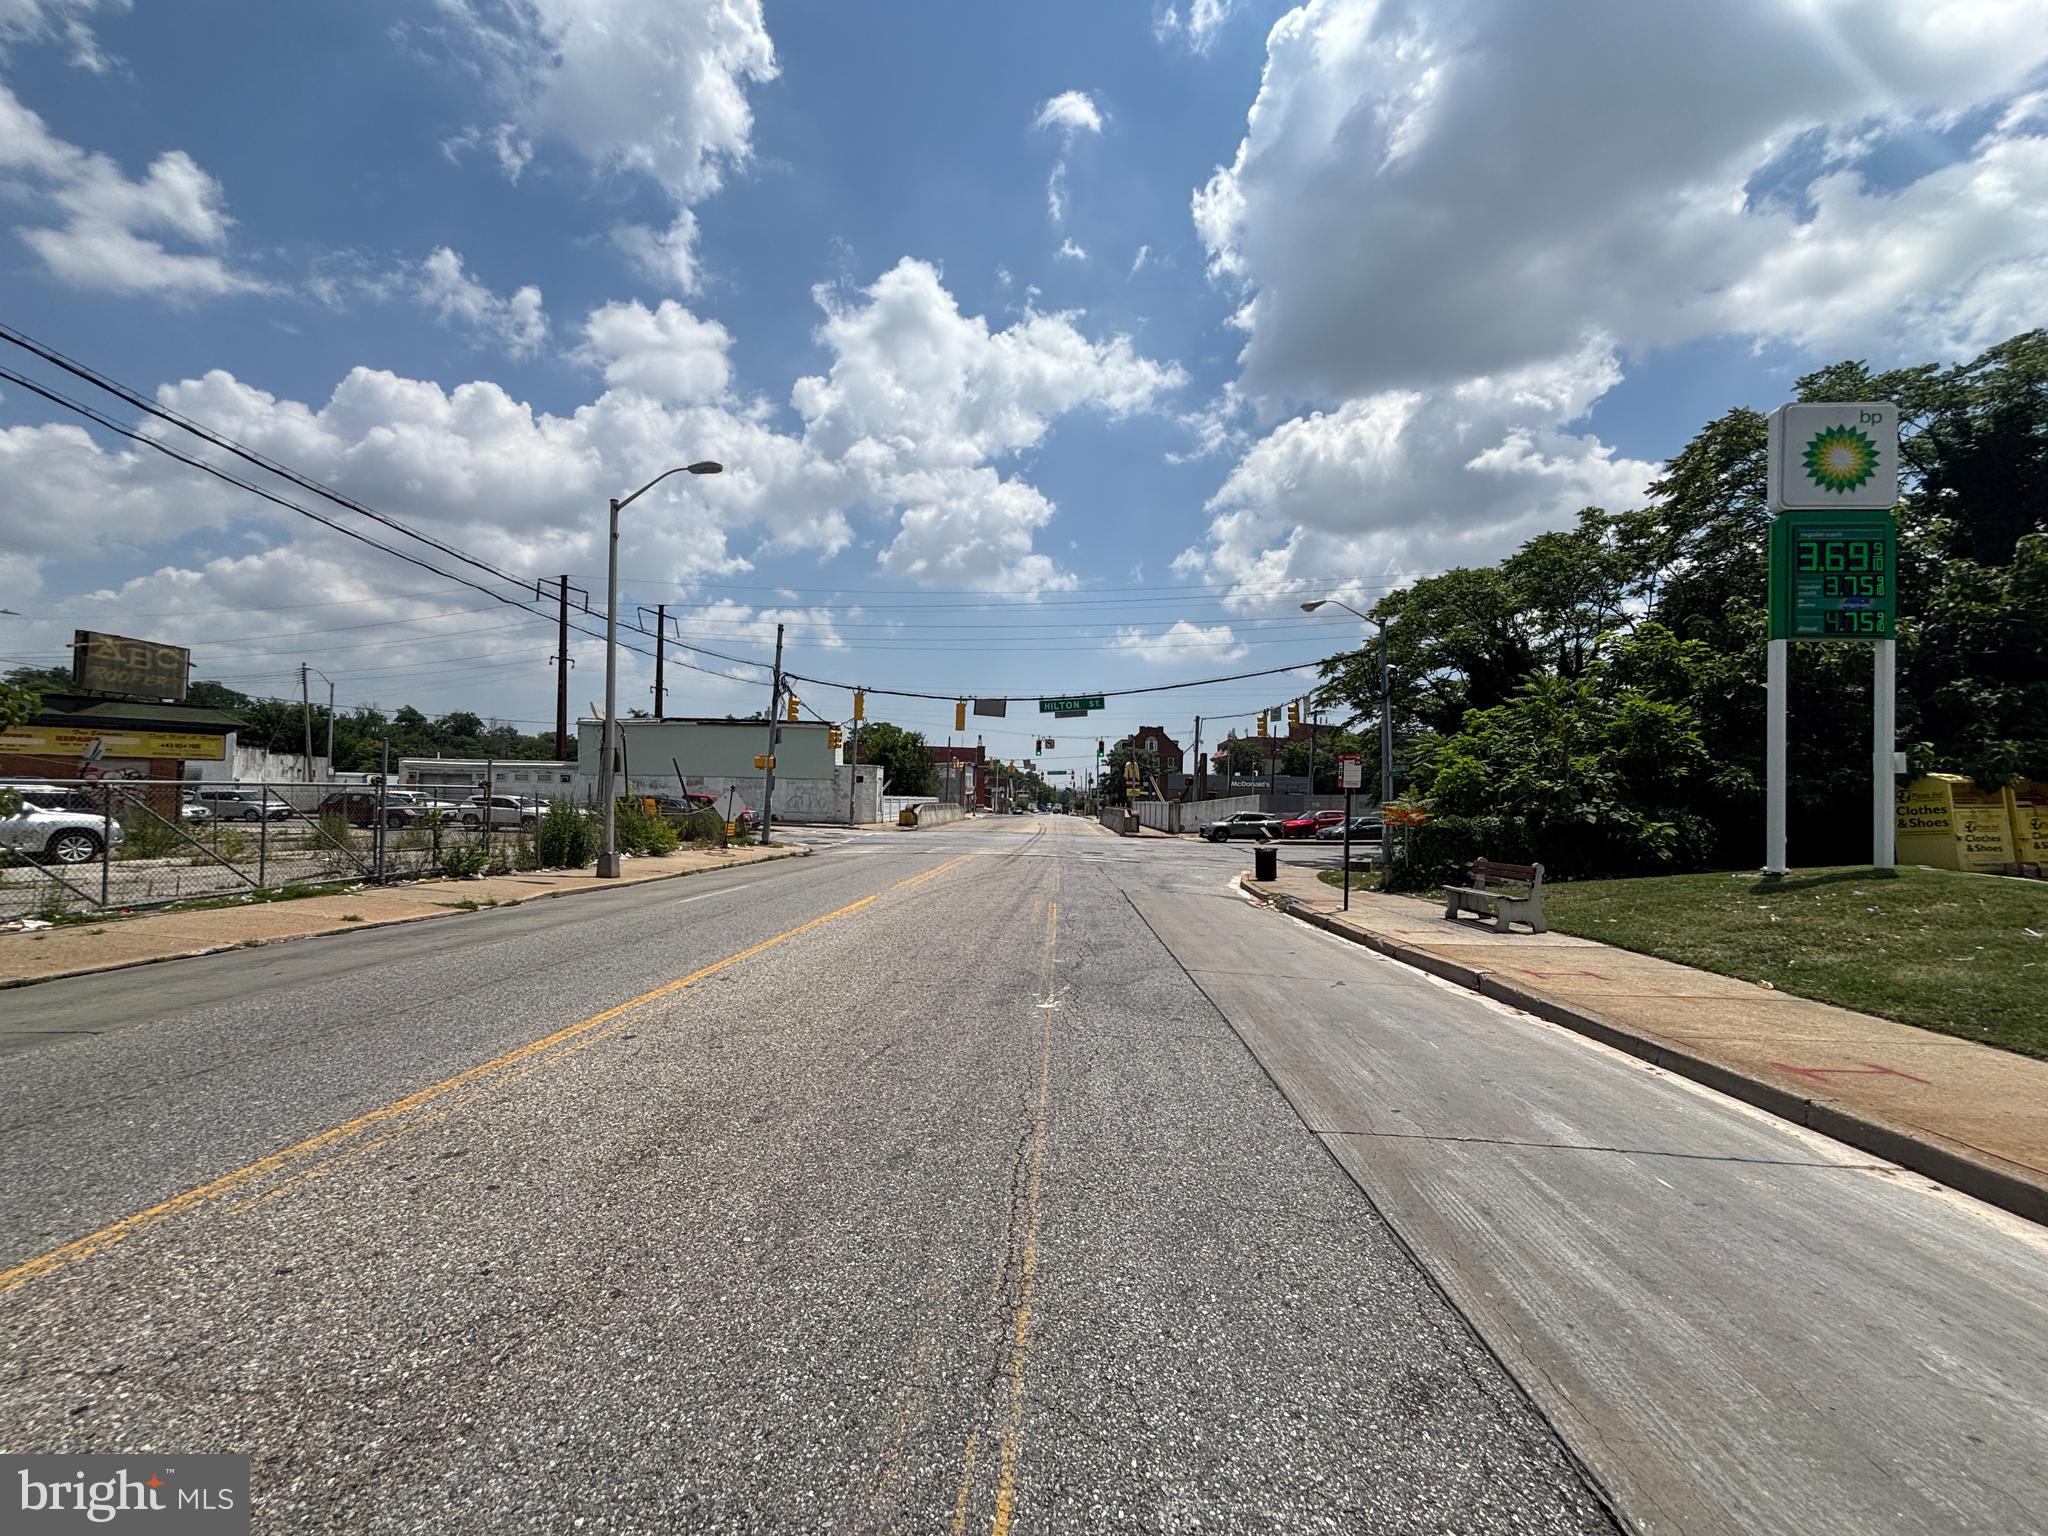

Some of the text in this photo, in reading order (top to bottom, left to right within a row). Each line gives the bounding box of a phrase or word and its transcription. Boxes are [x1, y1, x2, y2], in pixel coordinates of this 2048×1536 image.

[1860, 409, 1882, 427] bp
[1799, 542, 1869, 572] 3.69
[1825, 576, 1873, 596] 3.75
[1826, 612, 1873, 632] 4.75
[1044, 700, 1080, 711] HILTON
[1230, 780, 1271, 788] McDonald's
[1896, 805, 1947, 816] Clothes
[1897, 818, 1949, 828] & Shoes
[1965, 834, 2001, 843] Clothes
[1975, 844, 2003, 852] Shoes
